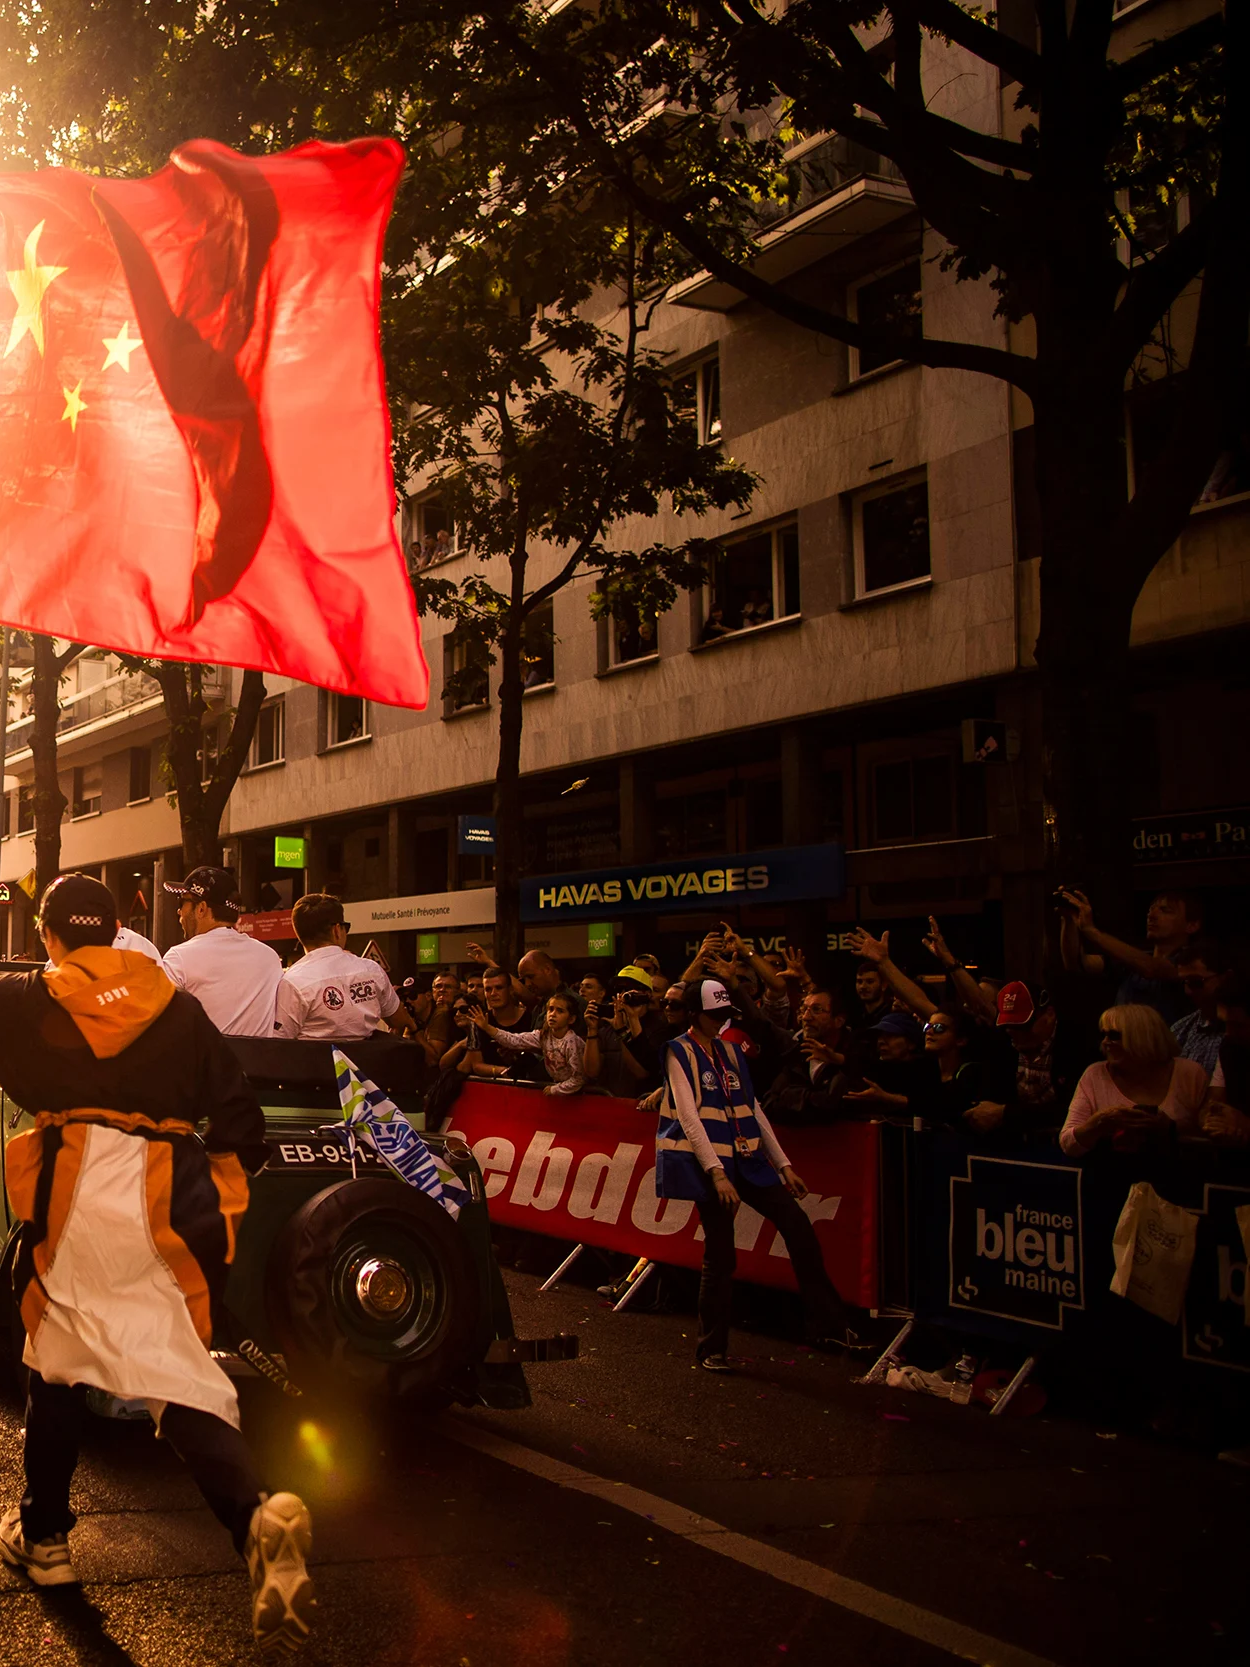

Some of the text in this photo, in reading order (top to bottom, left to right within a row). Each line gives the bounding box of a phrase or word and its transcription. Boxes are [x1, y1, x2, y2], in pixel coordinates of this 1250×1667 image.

[278, 850, 301, 862] mgen
[538, 864, 770, 909] HAVAS VOYAGES
[371, 905, 451, 921] Mutuelle Santé Prévoyance
[588, 939, 608, 950] mgen
[95, 985, 130, 1006] RACE
[1003, 993, 1017, 1002] 24
[279, 1144, 387, 1164] EB-951-
[1014, 1203, 1074, 1230] france
[975, 1207, 1075, 1274] bleu
[1004, 1266, 1076, 1299] maine
